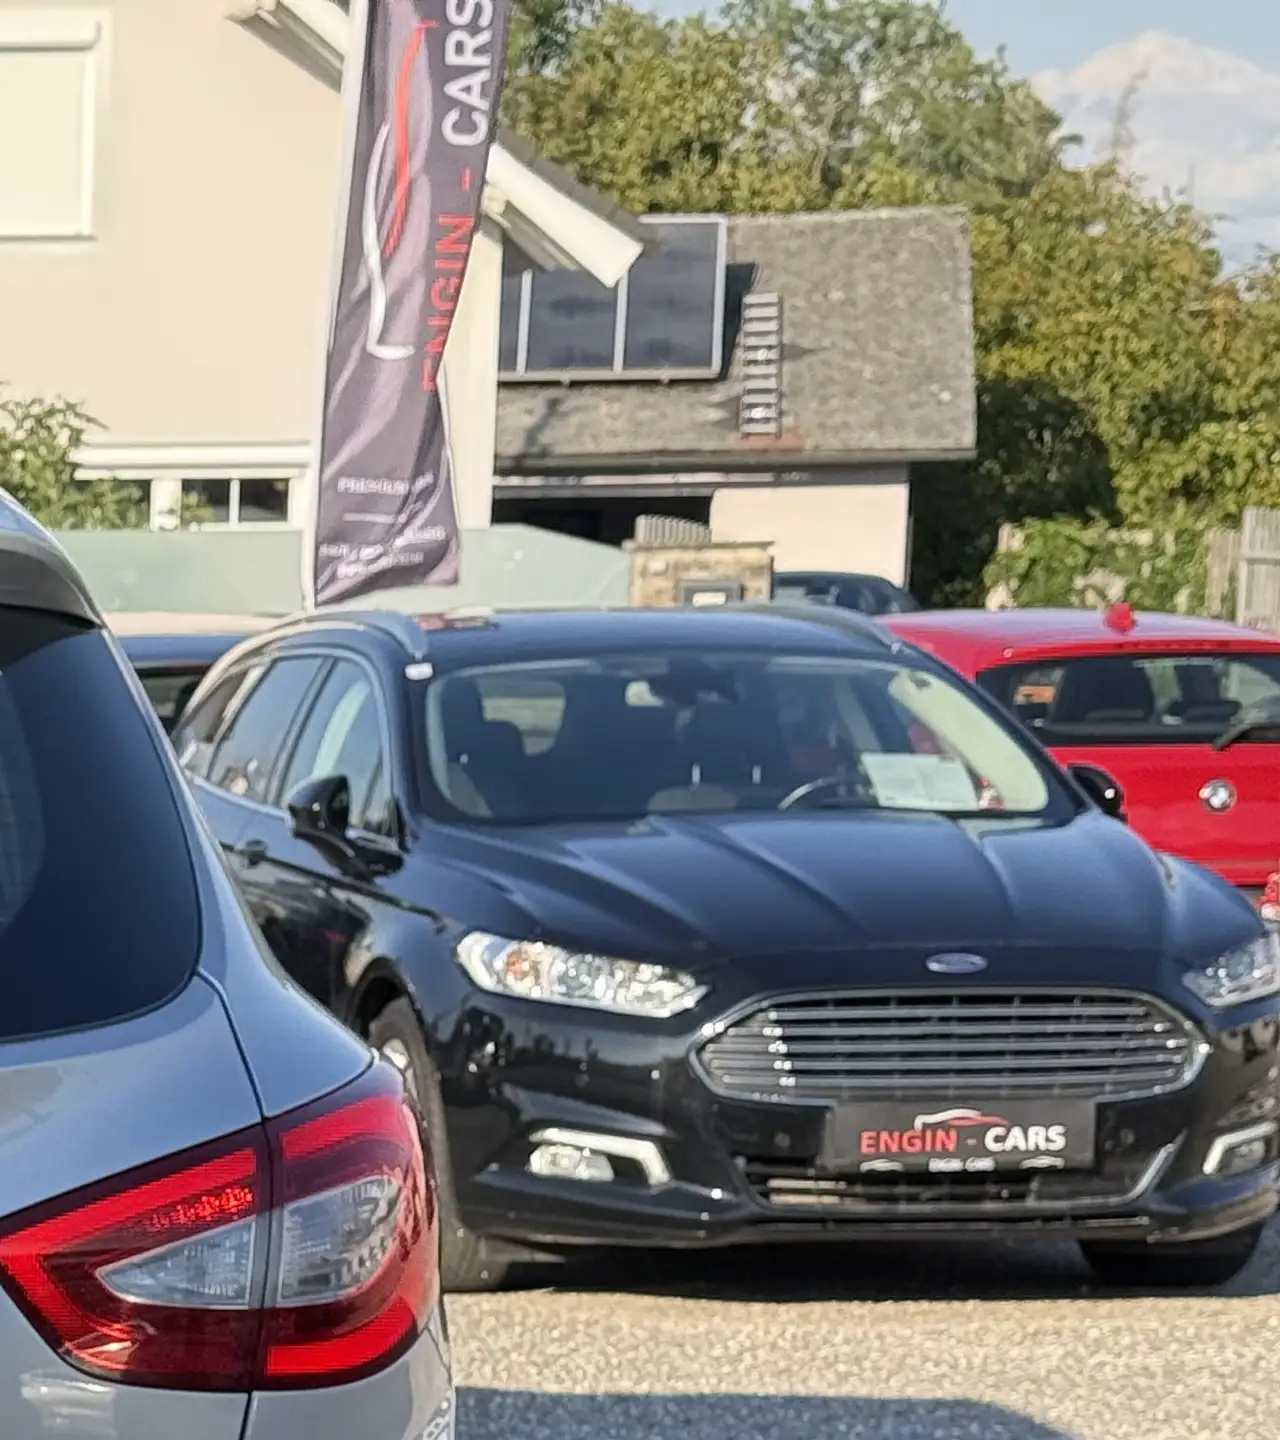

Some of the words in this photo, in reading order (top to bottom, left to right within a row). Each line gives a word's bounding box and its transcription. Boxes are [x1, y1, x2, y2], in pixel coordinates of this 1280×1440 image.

[441, 0, 494, 147] CARS
[860, 1128, 958, 1154] ENGIN
[983, 1125, 1067, 1152] CARS
